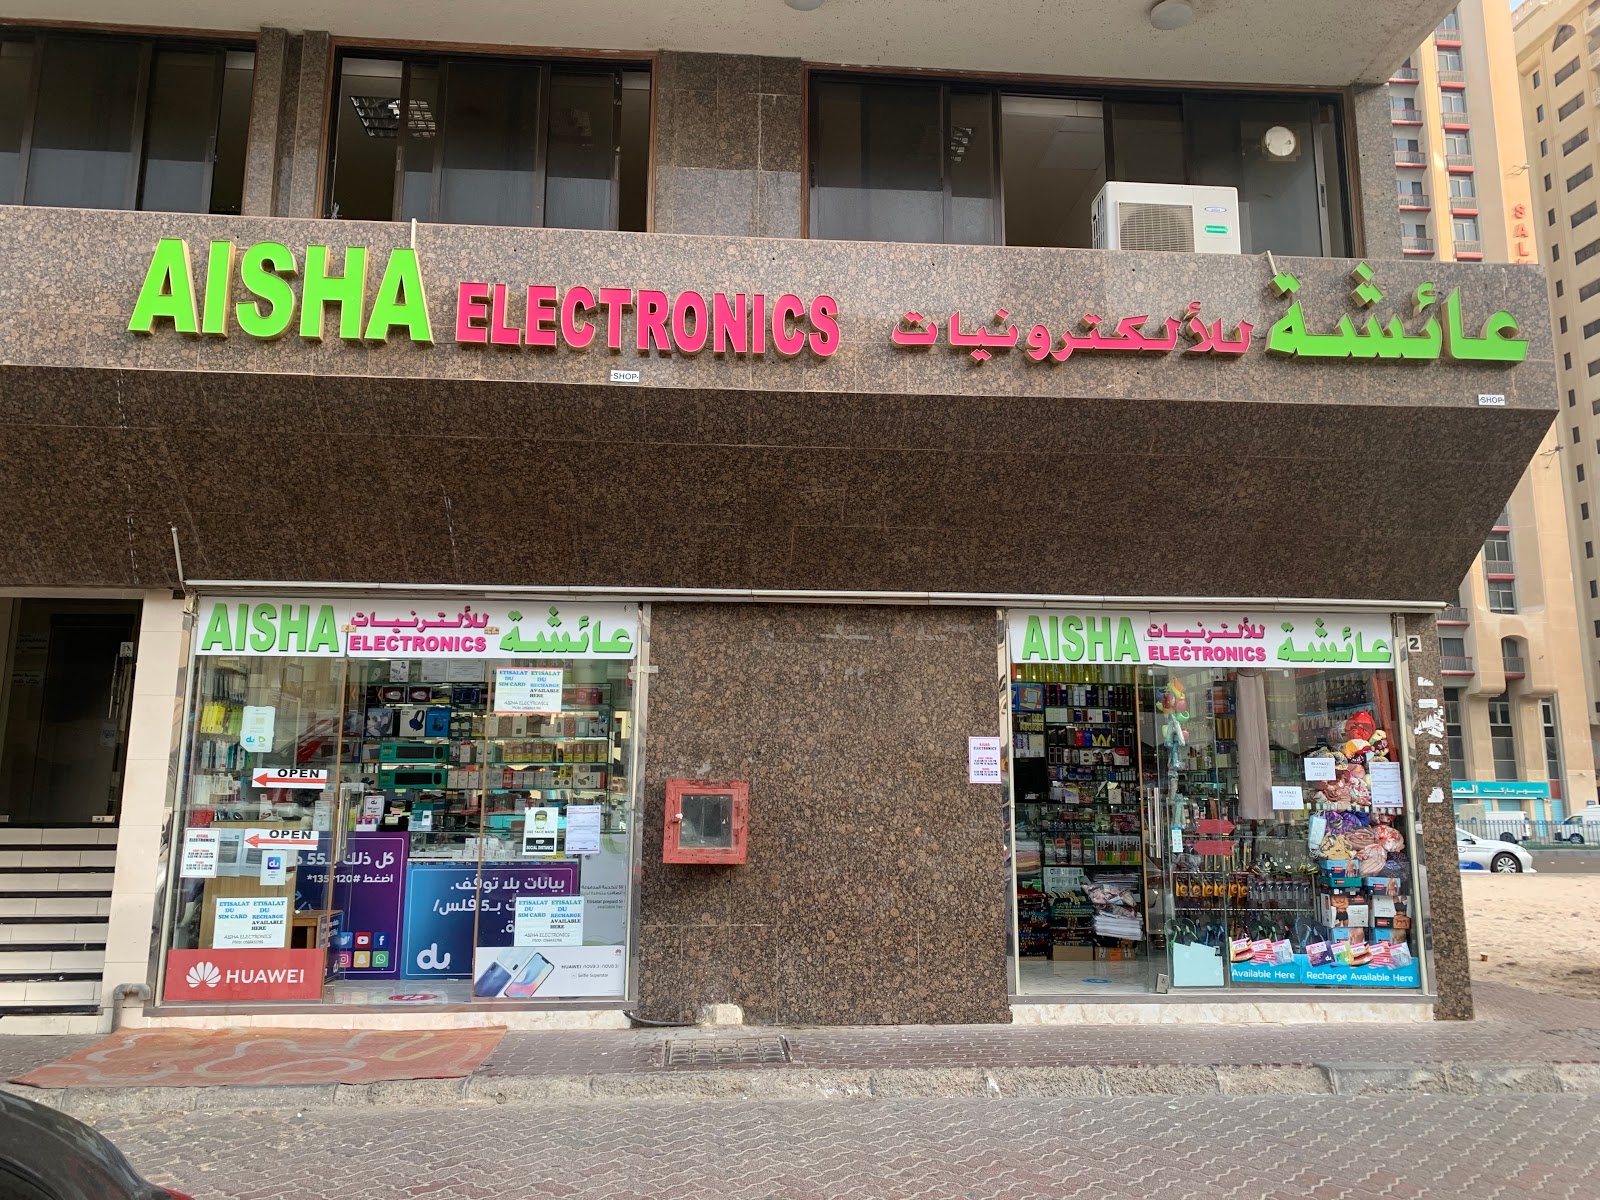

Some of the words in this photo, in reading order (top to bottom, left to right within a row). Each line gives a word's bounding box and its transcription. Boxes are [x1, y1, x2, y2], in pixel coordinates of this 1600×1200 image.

[1514, 203, 1537, 264] SAL
[127, 238, 434, 345] AISHA
[455, 281, 840, 358] ELECTRONICS
[1265, 261, 1530, 362] عائشة
[891, 301, 1254, 363] للألكترونيات
[201, 603, 340, 652] AISHA
[349, 635, 487, 652] ELECTRONICS
[499, 605, 634, 653] عائشة
[1021, 614, 1141, 662] AISHA
[1148, 645, 1267, 662] ELECTRONICS
[1276, 617, 1392, 663] عائشة
[1408, 637, 1420, 650] 2
[277, 769, 320, 779] OPEN
[268, 829, 312, 840] OPEN
[268, 859, 280, 868] du
[342, 851, 372, 865] ذلك
[375, 851, 395, 869] كل
[363, 873, 394, 883] اضغط
[502, 876, 520, 893] بلا
[524, 876, 565, 893] بيانات
[416, 942, 451, 970] du
[225, 969, 305, 984] HUAWEI
[1231, 969, 1272, 979] Available
[1274, 969, 1295, 979] Here
[1306, 971, 1348, 982] Recharge
[1350, 972, 1390, 982] Available
[1392, 973, 1414, 982] Here
